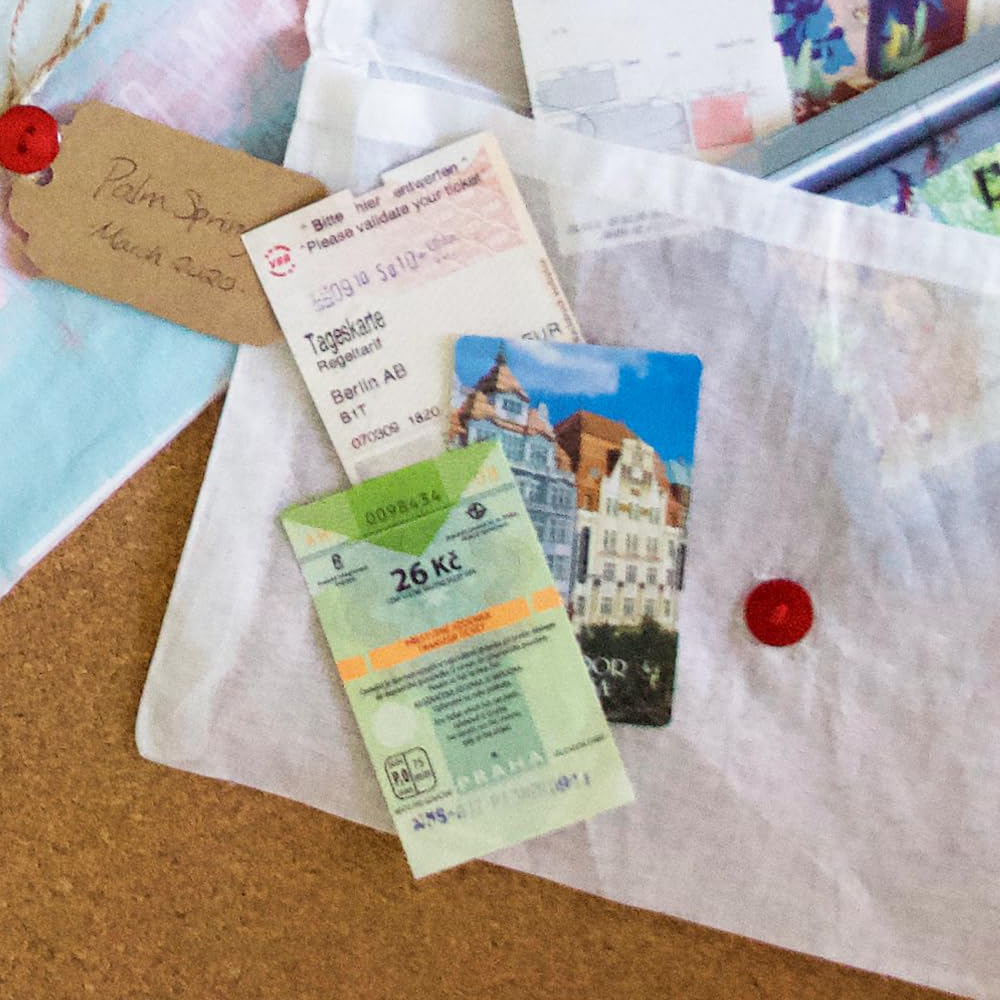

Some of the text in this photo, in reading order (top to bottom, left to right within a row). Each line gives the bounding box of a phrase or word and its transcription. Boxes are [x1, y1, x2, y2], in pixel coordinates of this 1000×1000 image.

[93, 156, 168, 208] Palm
[311, 162, 459, 232] Bitte hier entwerten
[355, 204, 410, 233] validate
[411, 189, 443, 213] your
[444, 172, 482, 197] ticket
[303, 307, 387, 357] Tageskarte
[330, 361, 409, 406] Berlin AB
[390, 566, 430, 594] 26
[431, 548, 465, 580] Kč
